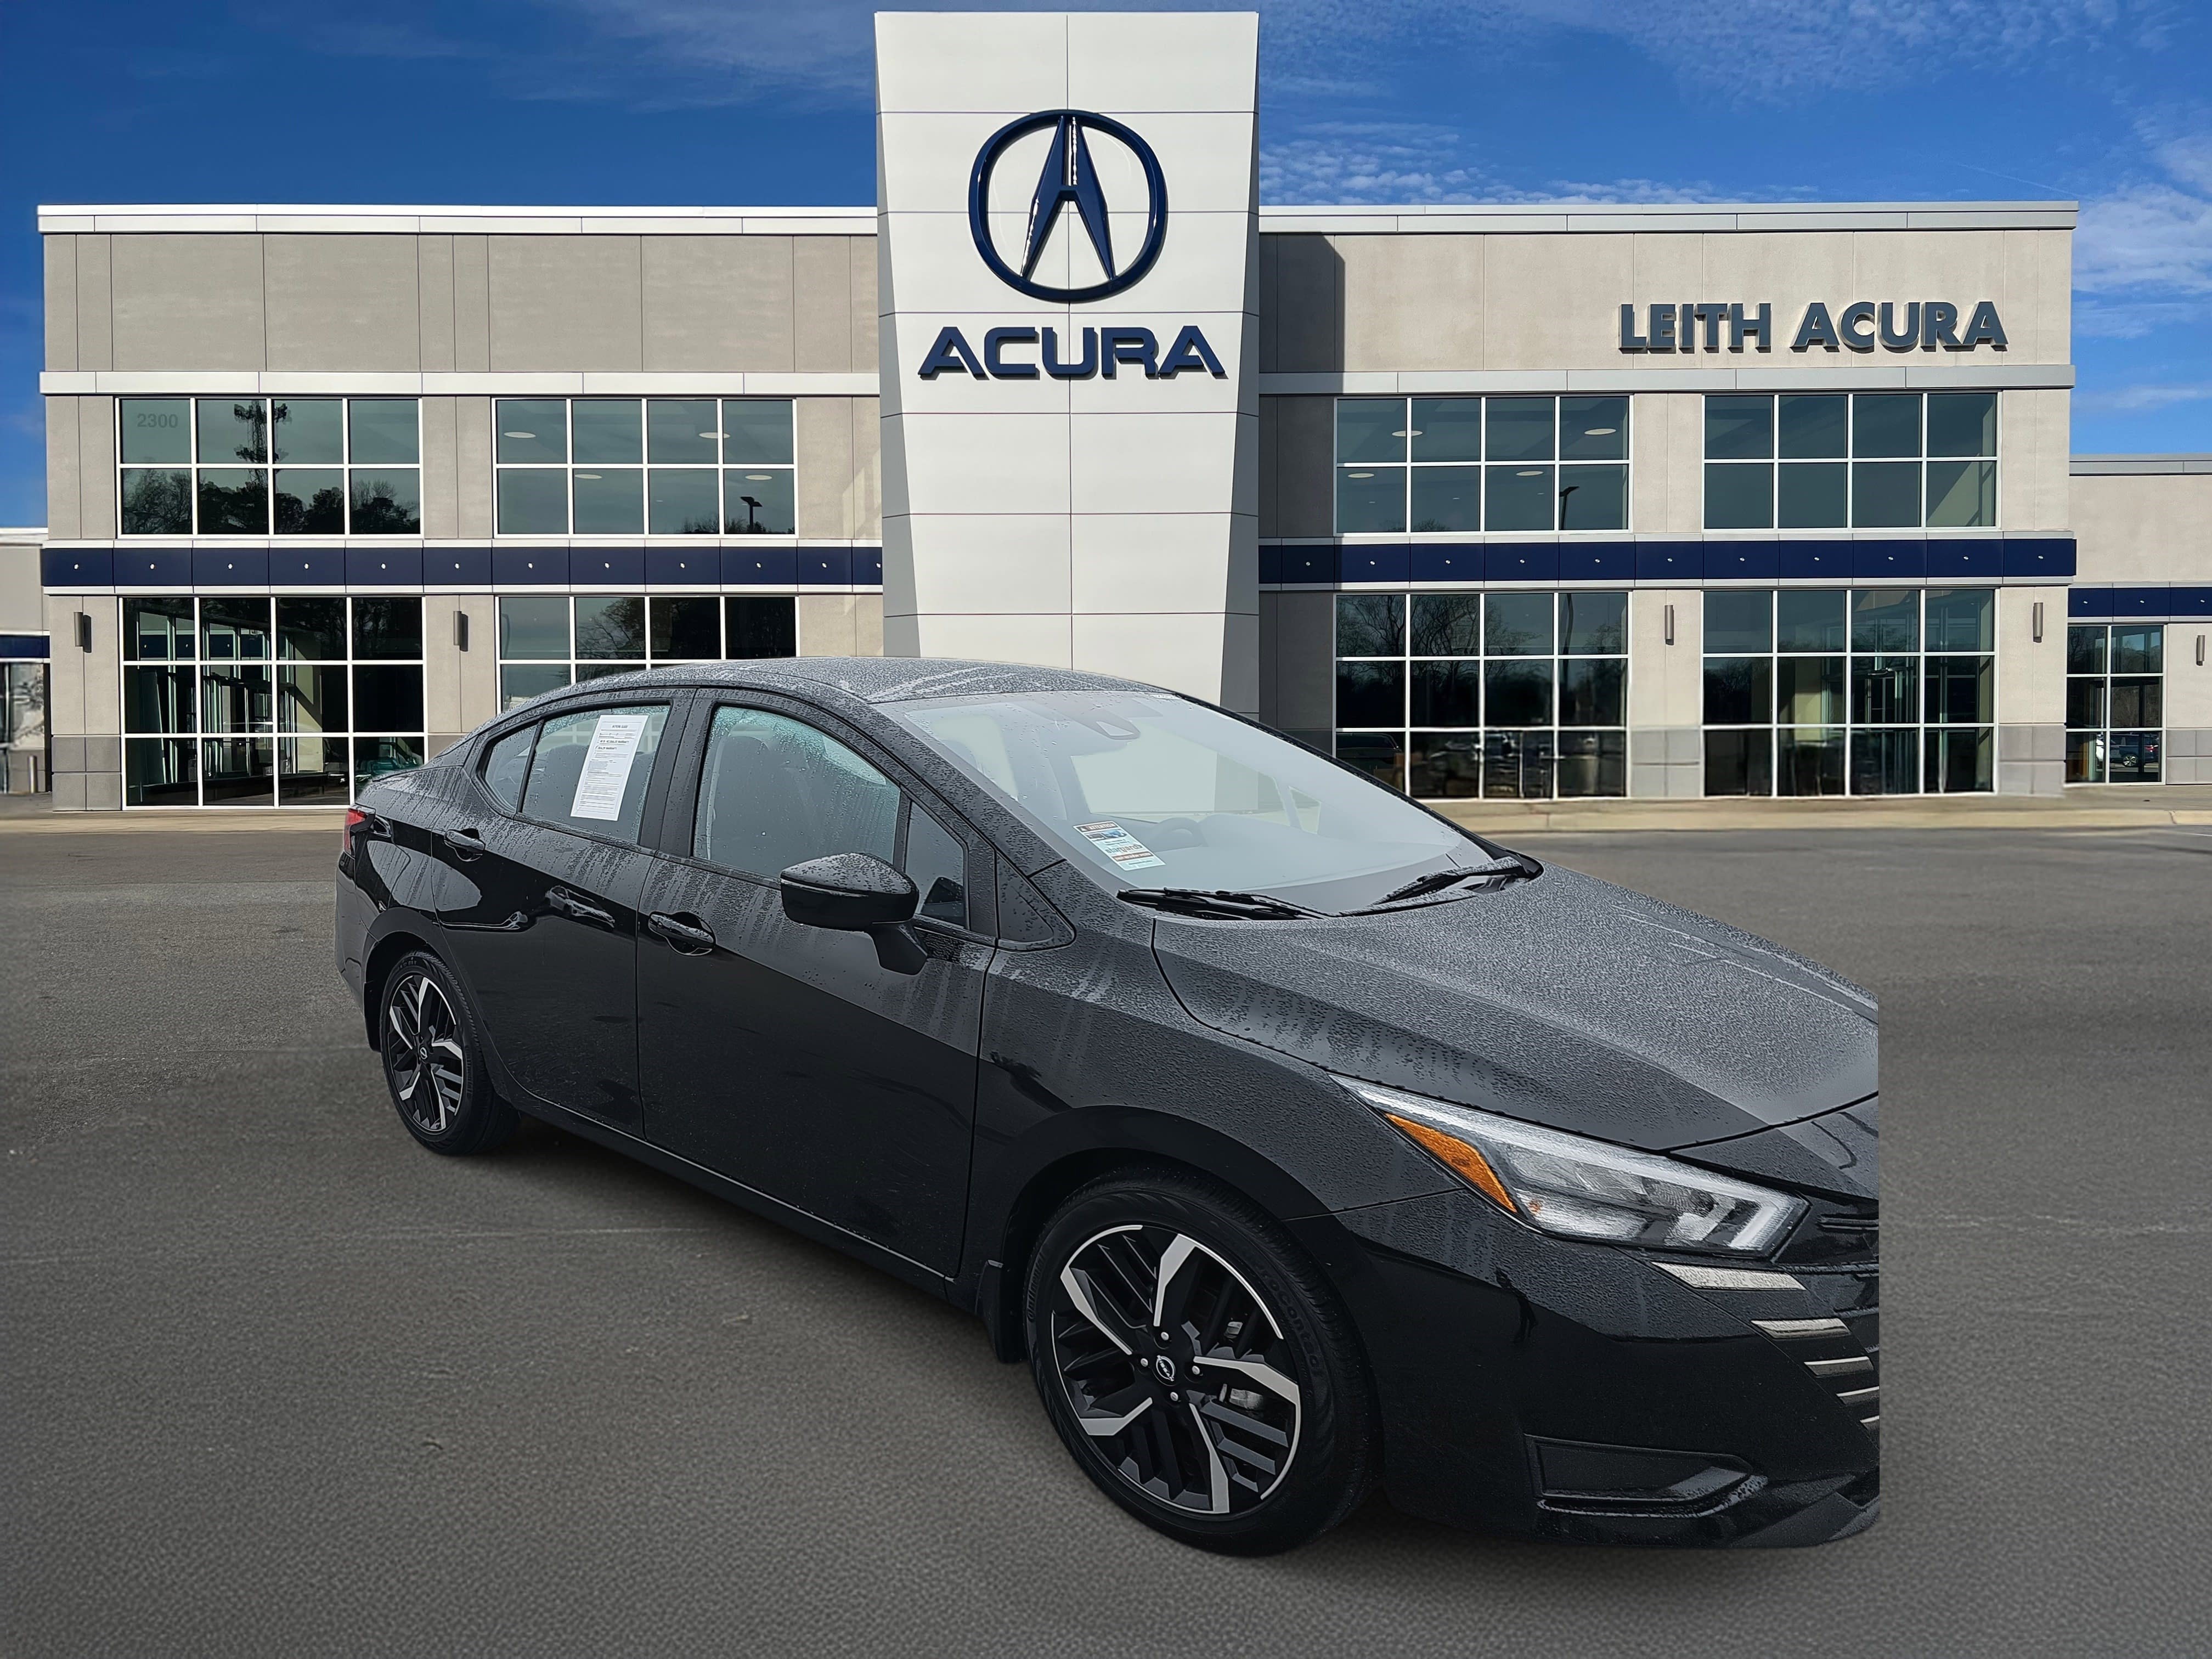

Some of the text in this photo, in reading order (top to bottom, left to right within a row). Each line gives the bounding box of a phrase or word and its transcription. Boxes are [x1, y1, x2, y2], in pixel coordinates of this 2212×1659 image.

[918, 325, 1229, 381] ACURA
[1618, 301, 2009, 354] LEITH ACURA
[137, 413, 178, 428] 2300
